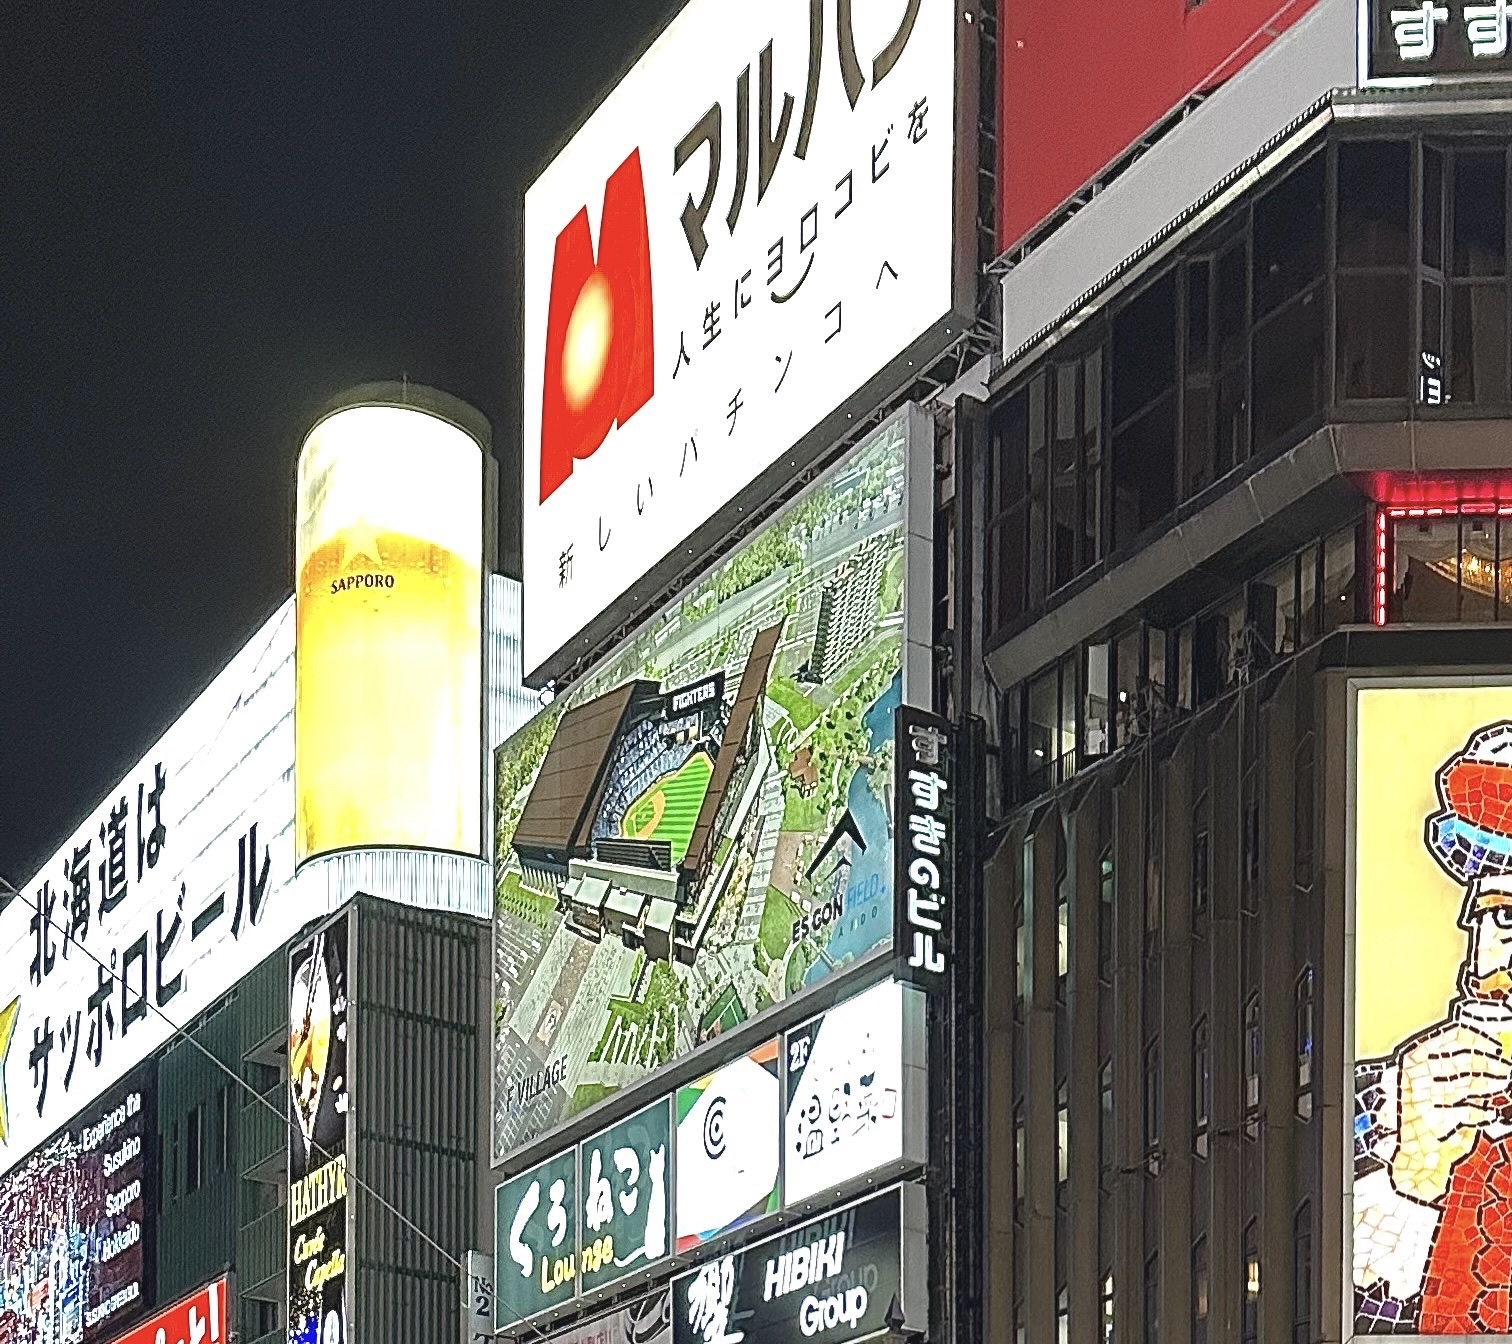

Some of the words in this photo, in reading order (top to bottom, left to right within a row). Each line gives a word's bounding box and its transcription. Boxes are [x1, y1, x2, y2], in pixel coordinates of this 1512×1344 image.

[672, 95, 930, 380] 人生にヨロコビを
[331, 574, 394, 594] SAPPORO
[672, 681, 716, 712] FIGHTERS
[28, 762, 168, 990] 北海道は
[907, 724, 949, 973] すすきのビル
[28, 820, 272, 1120] サッポロビール
[506, 1085, 515, 1113] F
[517, 1053, 568, 1105] VILLAGE
[789, 1034, 811, 1072] 2F
[103, 1135, 141, 1178] Susukino
[105, 1179, 141, 1218] Sapporo
[290, 1153, 348, 1227] HATHYR
[541, 1234, 614, 1294] Lounge
[763, 1231, 846, 1303] HIBIKI
[800, 1285, 869, 1337] Group
